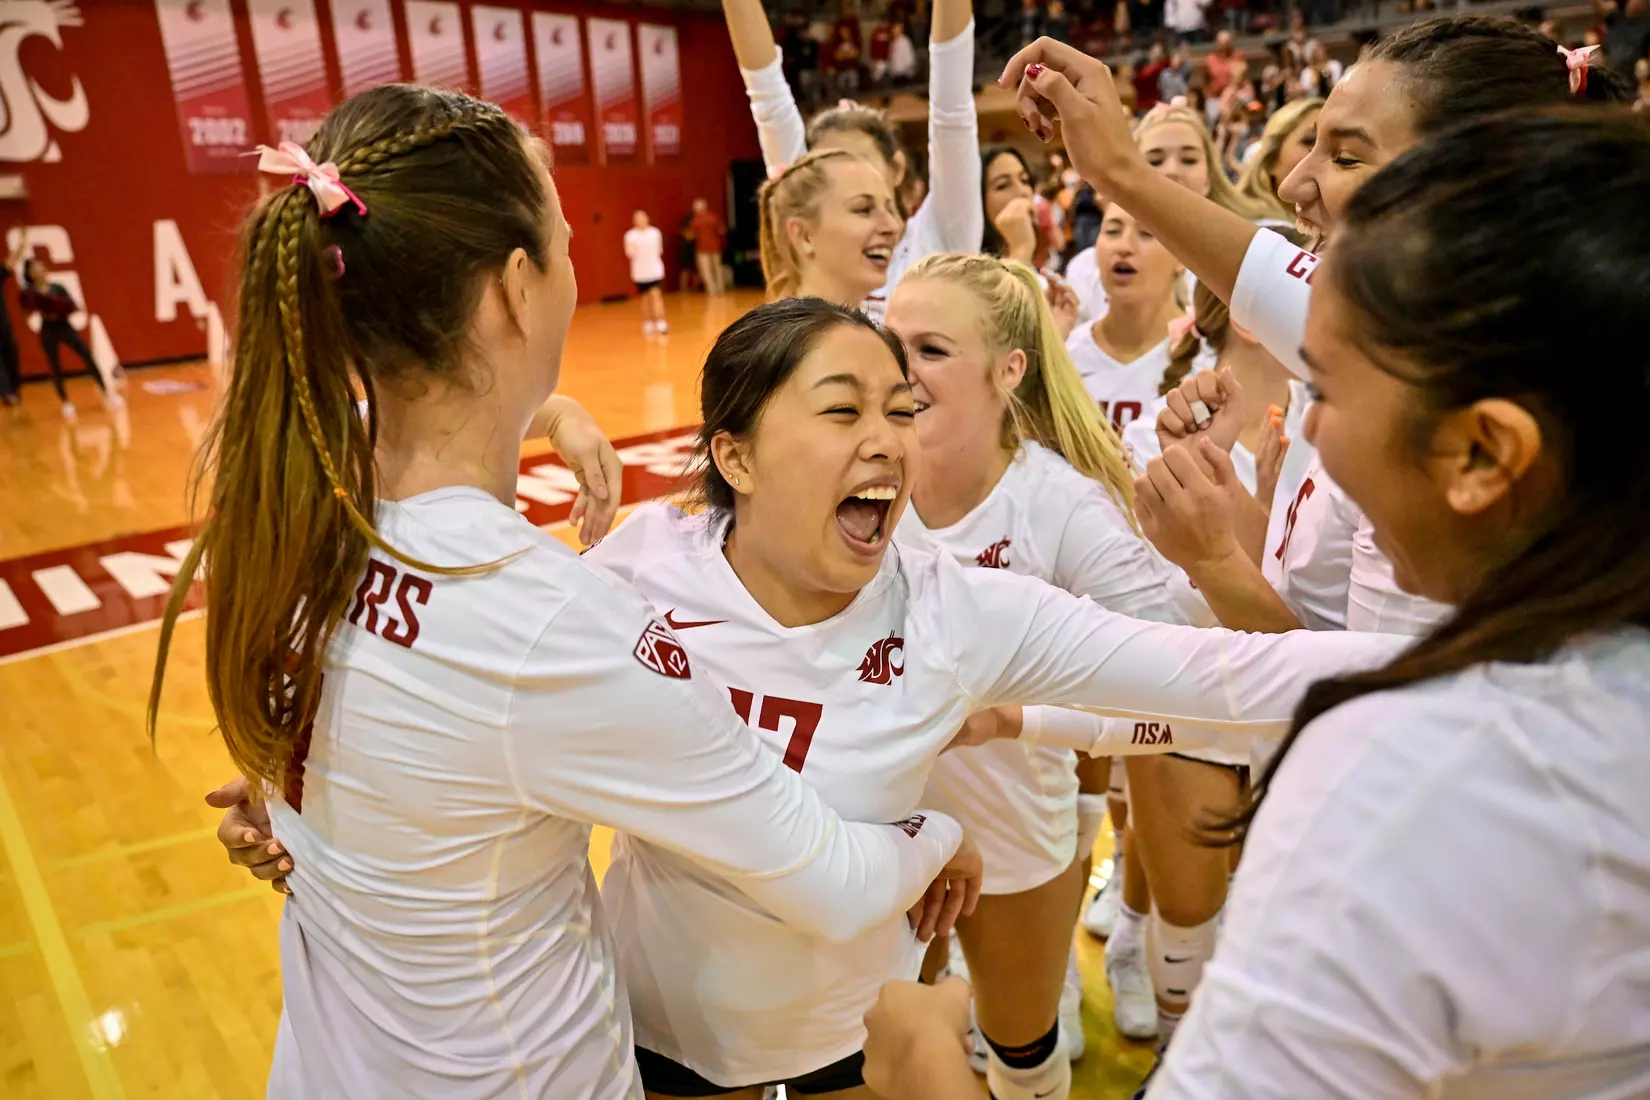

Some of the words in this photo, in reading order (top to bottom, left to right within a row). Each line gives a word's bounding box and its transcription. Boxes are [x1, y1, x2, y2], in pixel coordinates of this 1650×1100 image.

[345, 557, 434, 649] RS
[635, 621, 680, 674] PAC
[667, 649, 687, 676] 12
[1131, 722, 1173, 744] WSU
